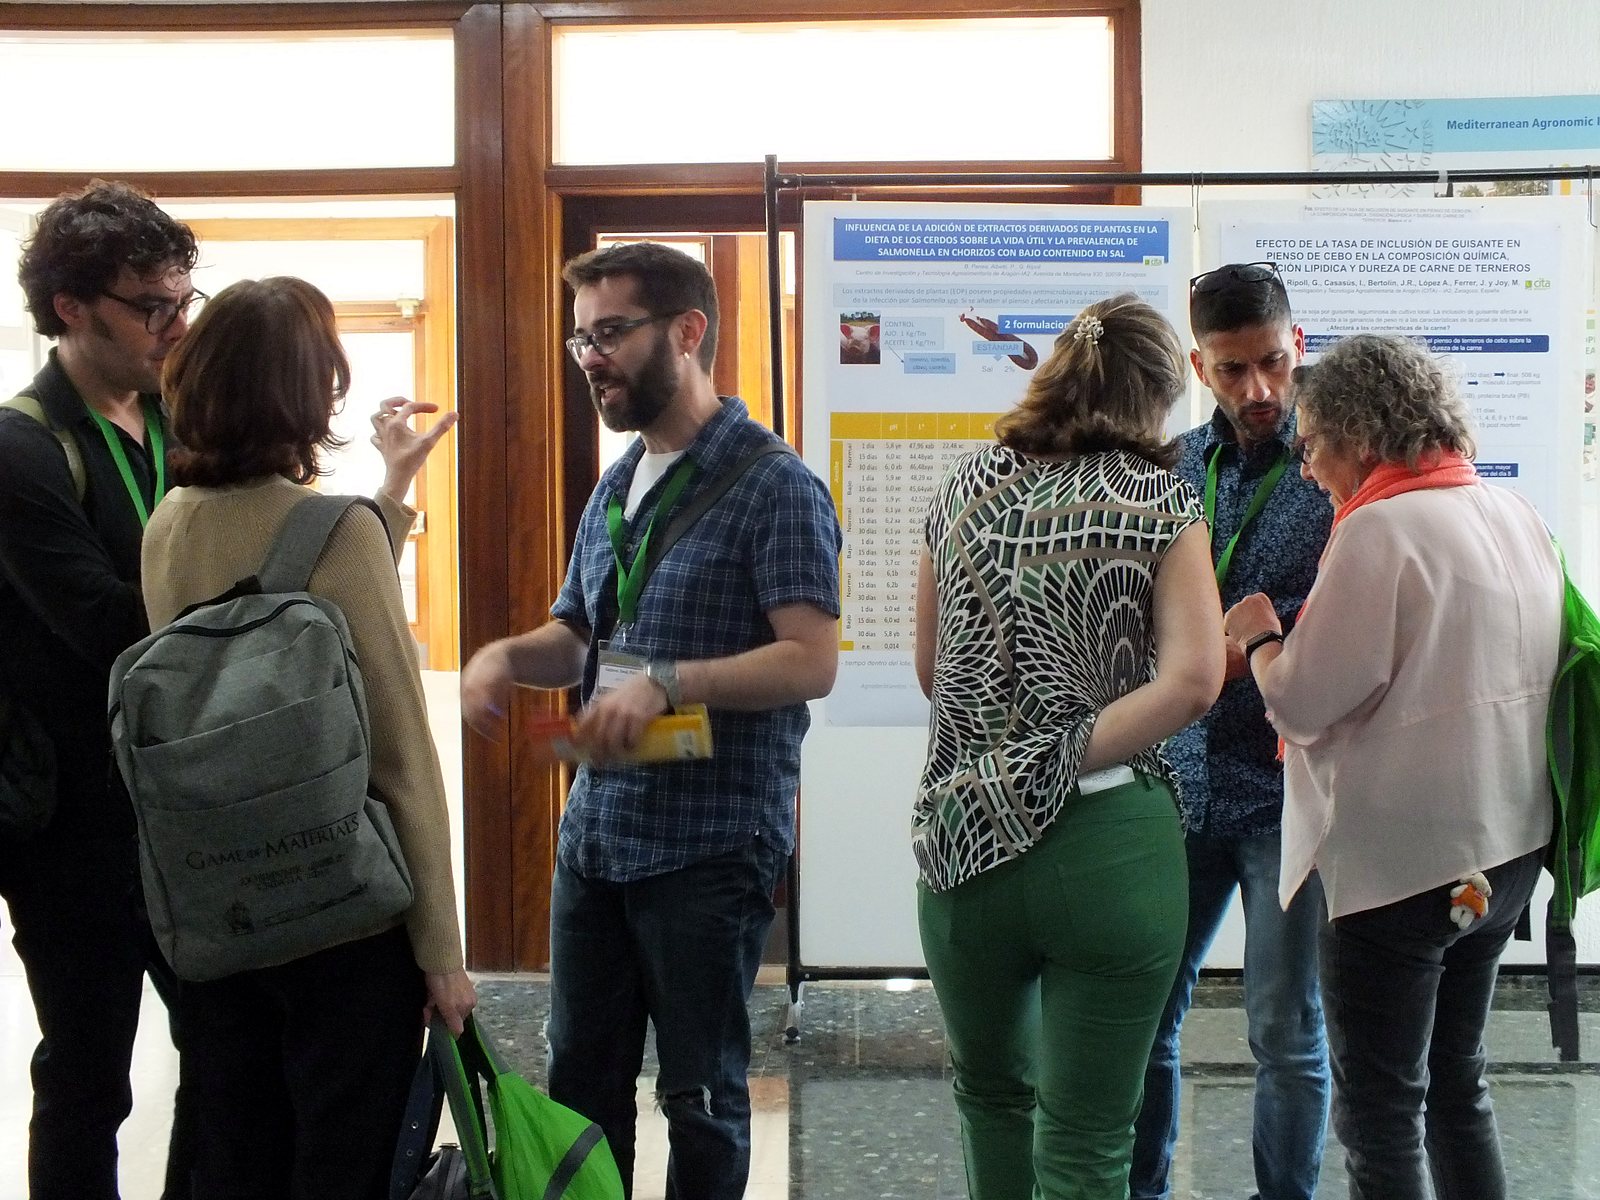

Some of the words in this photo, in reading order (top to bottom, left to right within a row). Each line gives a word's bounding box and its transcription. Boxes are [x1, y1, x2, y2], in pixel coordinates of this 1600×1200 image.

[1446, 119, 1528, 130] Mediterranean
[1531, 116, 1593, 130] Agronomic
[845, 224, 896, 232] INFLUENCIA
[898, 224, 910, 232] DE
[912, 224, 923, 233] LA
[924, 221, 962, 233] ADICIÓN
[964, 224, 975, 233] DE
[977, 224, 1027, 233] EXTRACTOS
[1029, 225, 1078, 233] DERIVADOS
[1080, 225, 1092, 233] DE
[1094, 225, 1132, 234] PLANTAS
[1133, 225, 1145, 234] EN
[1147, 225, 1158, 234] LA
[865, 236, 890, 244] DIETA
[891, 236, 903, 244] DE
[905, 236, 921, 245] LOS
[923, 236, 958, 245] CERDOS
[960, 237, 989, 245] SOBRE
[990, 237, 1001, 245] LA
[1004, 237, 1024, 245] VIDA
[1026, 235, 1045, 245] ÚTIL
[1047, 237, 1052, 245] Y
[1054, 237, 1066, 245] LA
[1068, 237, 1125, 246] PREVALENCIA
[1127, 238, 1138, 246] DE
[1255, 239, 1296, 248] EFECTO
[1299, 239, 1313, 248] DE
[1316, 239, 1329, 248] LA
[1331, 239, 1358, 248] TASA
[1360, 239, 1374, 248] DE
[1377, 237, 1432, 248] INCLUSIÓN
[1435, 239, 1449, 248] DE
[1451, 239, 1504, 248] GUISANTE
[1506, 239, 1521, 248] EN
[878, 248, 936, 257] SALMONELLA
[938, 249, 950, 257] EN
[951, 249, 995, 257] CHORIZOS
[997, 249, 1018, 258] CON
[1018, 249, 1041, 258] BAJO
[1043, 249, 1094, 258] CONTENIDO
[1096, 249, 1107, 258] EN
[1110, 249, 1125, 258] SAL
[1266, 252, 1304, 260] PIENSO
[1307, 252, 1321, 260] DE
[1324, 252, 1353, 260] CEBO
[1355, 252, 1369, 260] EN
[1371, 252, 1385, 260] LA
[1388, 249, 1460, 260] COMPOSICIÓN
[1462, 250, 1509, 262] QUÍMICA,
[1304, 264, 1347, 272] LIPIDICA
[1349, 264, 1356, 272] Y
[1359, 264, 1400, 272] DUREZA
[1403, 264, 1417, 272] DE
[1419, 264, 1455, 272] CARNE
[1458, 264, 1472, 272] DE
[1475, 264, 1531, 272] TERNEROS
[1287, 279, 1309, 287] Ripoll,
[1418, 278, 1441, 288] López
[1454, 279, 1478, 287] Ferrer,
[1534, 278, 1551, 288] cita
[1004, 320, 1010, 329] 2
